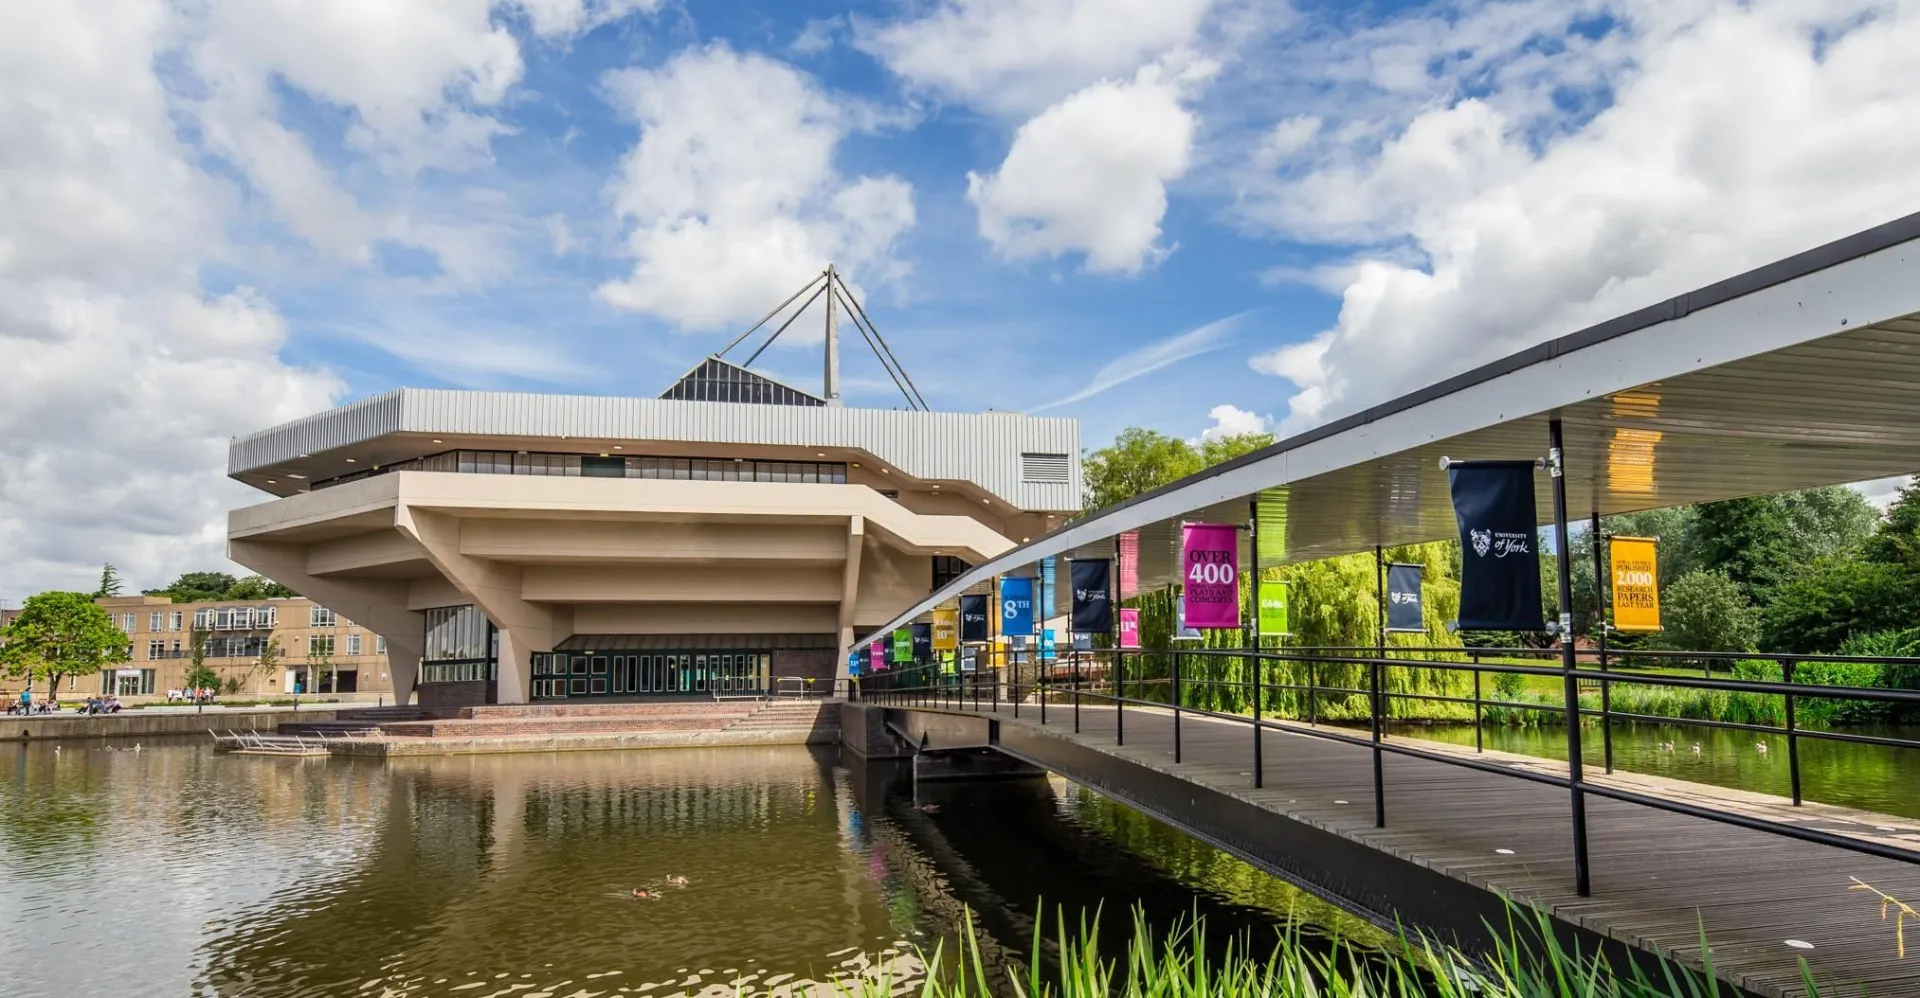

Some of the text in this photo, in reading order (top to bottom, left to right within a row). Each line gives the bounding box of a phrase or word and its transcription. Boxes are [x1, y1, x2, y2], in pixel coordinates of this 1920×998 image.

[1190, 550, 1232, 564] OVER
[1494, 539, 1530, 558] of York
[1189, 563, 1234, 584] 400
[1618, 593, 1654, 602] PAPERS
[1004, 600, 1030, 619] 8TH
